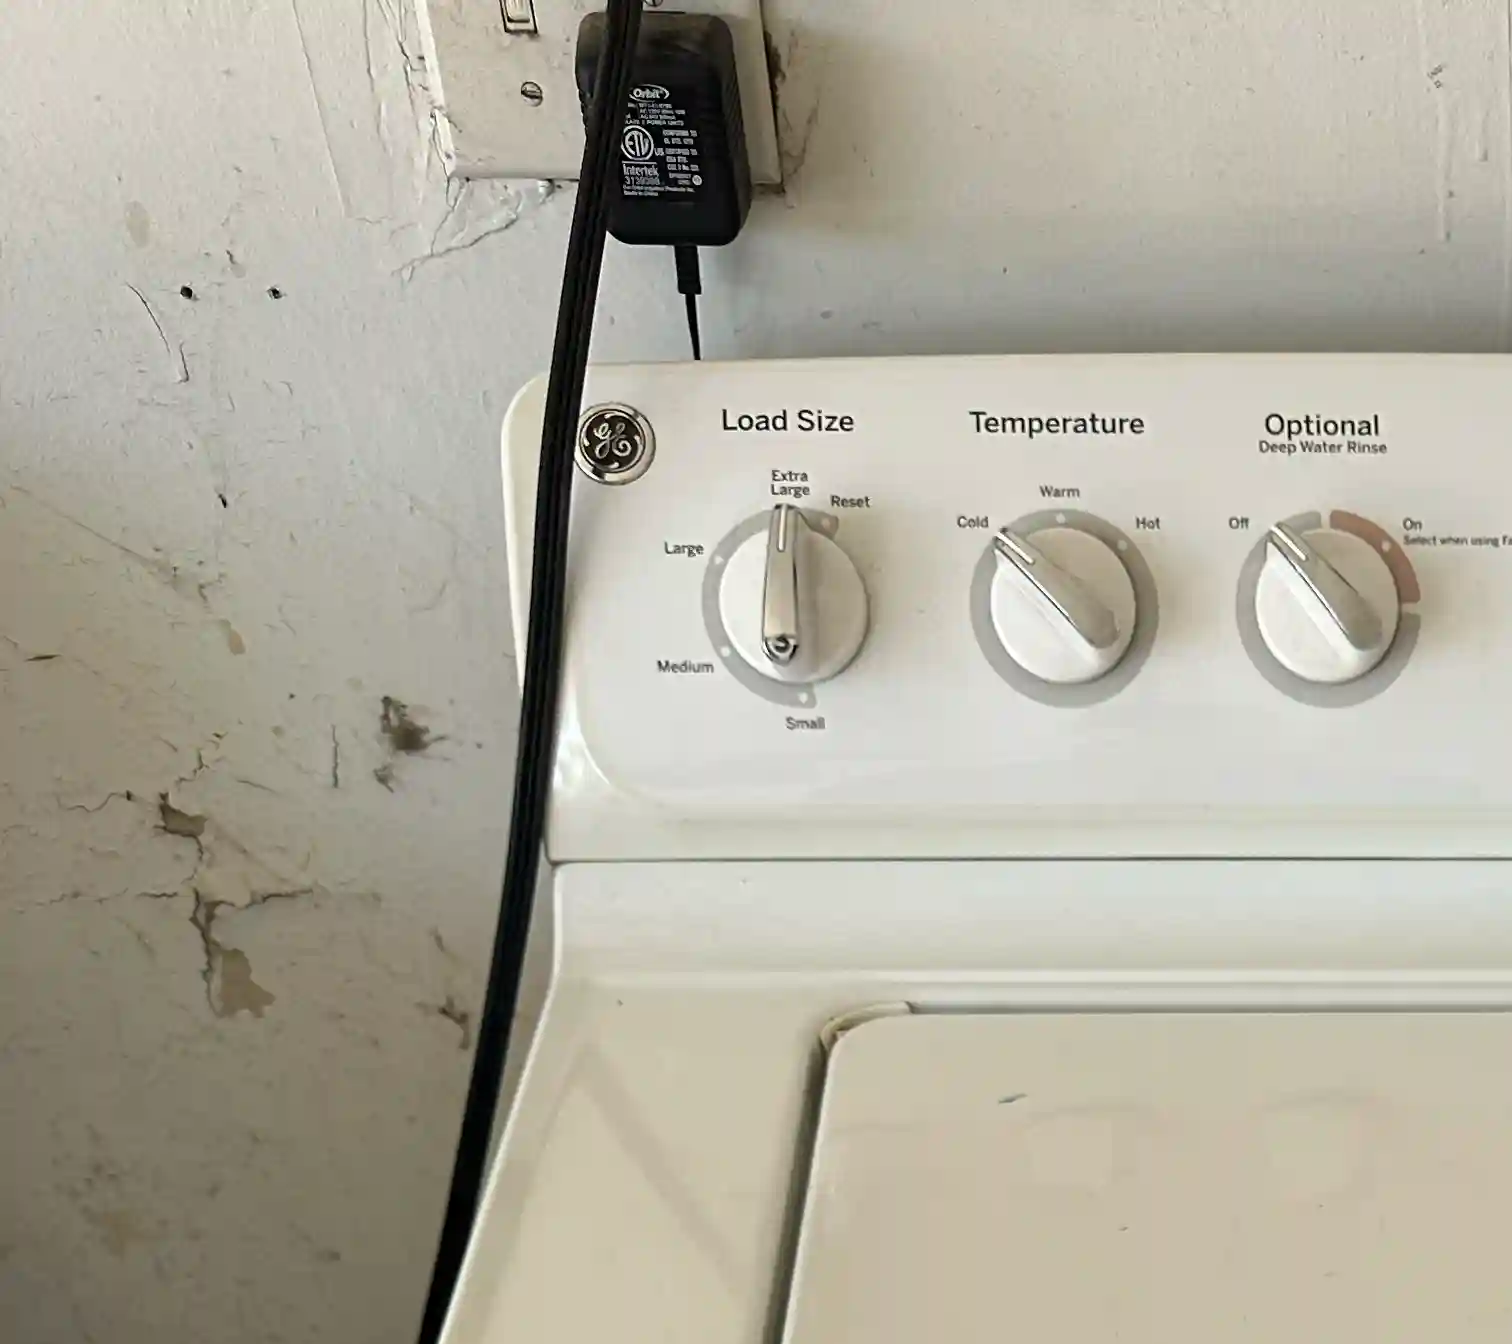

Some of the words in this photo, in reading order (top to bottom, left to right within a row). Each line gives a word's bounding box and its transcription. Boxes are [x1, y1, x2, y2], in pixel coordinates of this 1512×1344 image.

[722, 409, 787, 431] Load
[798, 410, 853, 431] Size
[969, 412, 1144, 439] Temperature
[1265, 414, 1378, 438] Optional
[1259, 441, 1296, 455] Deep
[1300, 441, 1342, 453] Water
[1347, 441, 1387, 454] Rinse
[771, 470, 808, 482] Extra
[771, 484, 809, 497] Large
[1040, 486, 1080, 497] Warm
[831, 495, 870, 508] Reset
[957, 516, 988, 528] Cold
[1136, 518, 1160, 529] Hot
[1229, 517, 1249, 529] Off
[1403, 518, 1422, 531] On
[1403, 535, 1436, 548] Select
[1440, 536, 1468, 545] when
[1471, 537, 1498, 548] using
[665, 542, 704, 556] Large
[657, 660, 714, 673] Medium
[786, 717, 825, 730] Small
